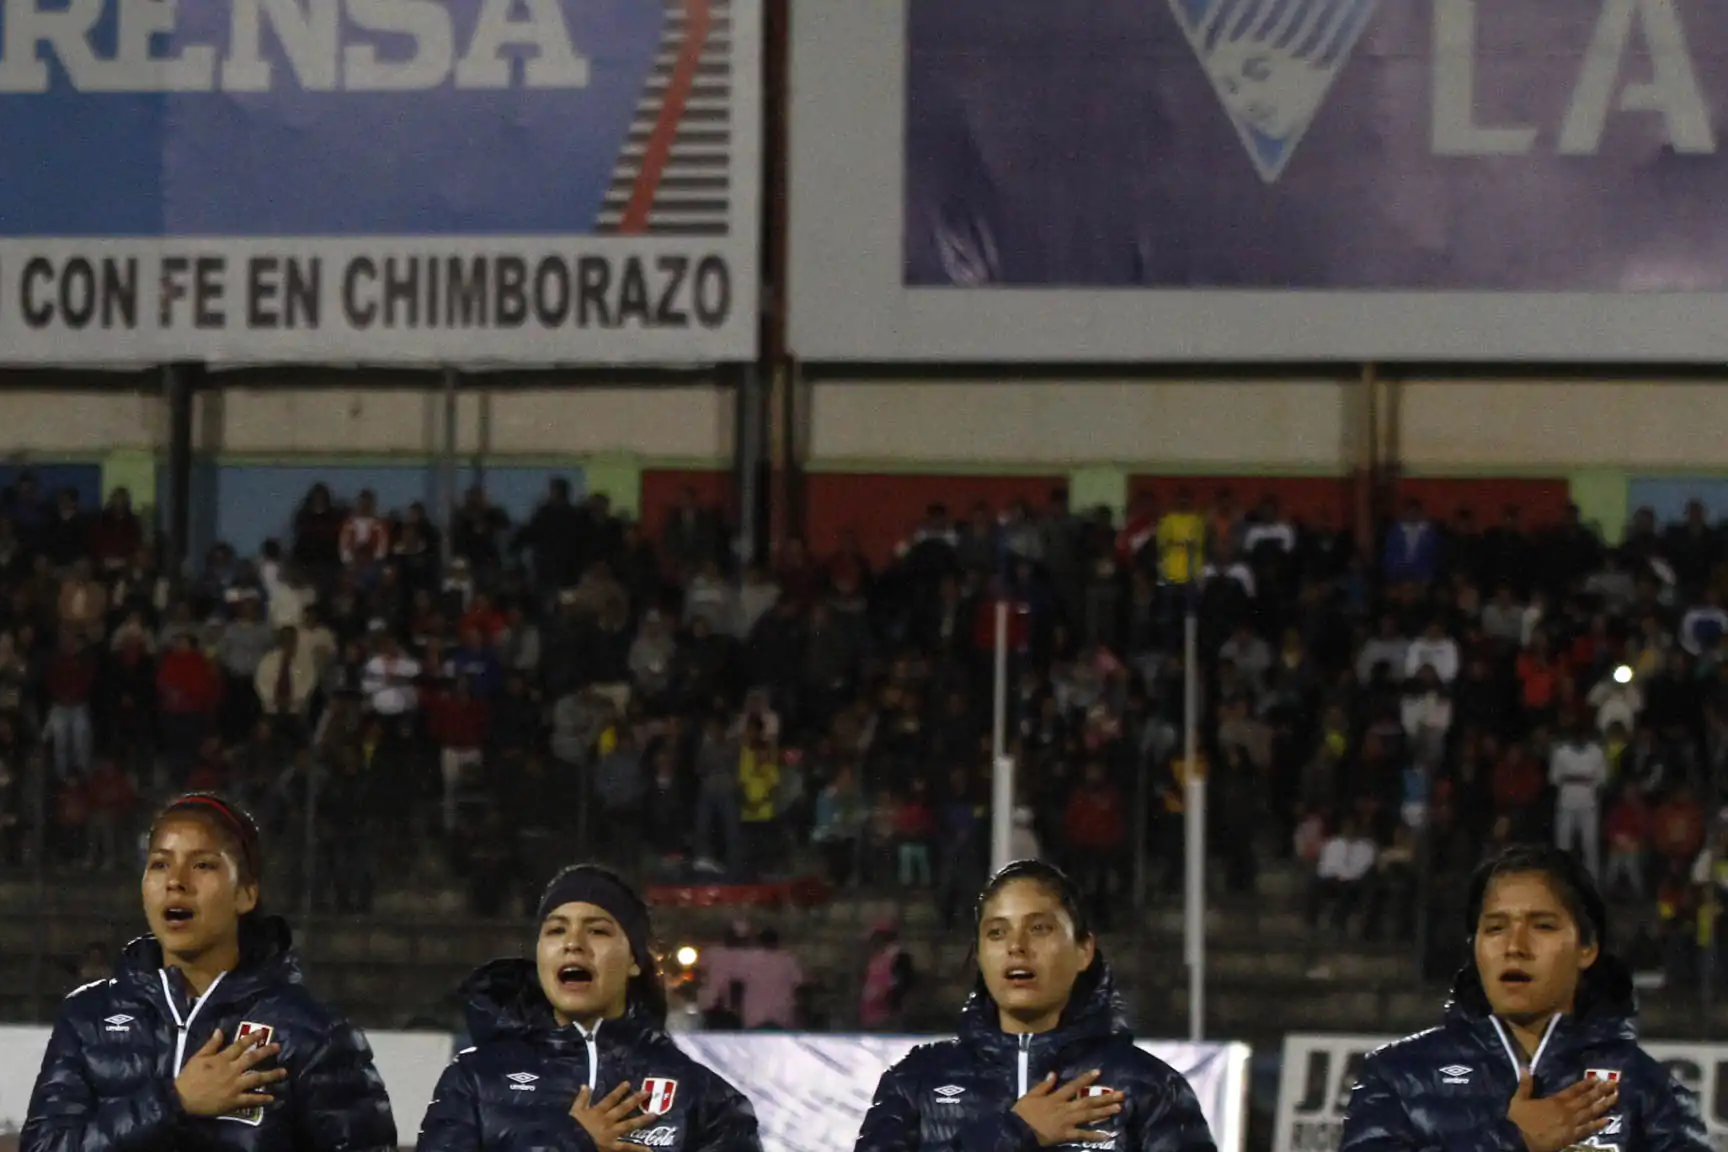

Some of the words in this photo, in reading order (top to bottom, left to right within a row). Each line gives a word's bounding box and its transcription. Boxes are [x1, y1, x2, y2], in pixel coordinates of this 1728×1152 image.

[19, 255, 140, 330] CON
[157, 255, 227, 328] FE
[246, 255, 320, 328] EN
[341, 254, 732, 329] CHIMBORAZO
